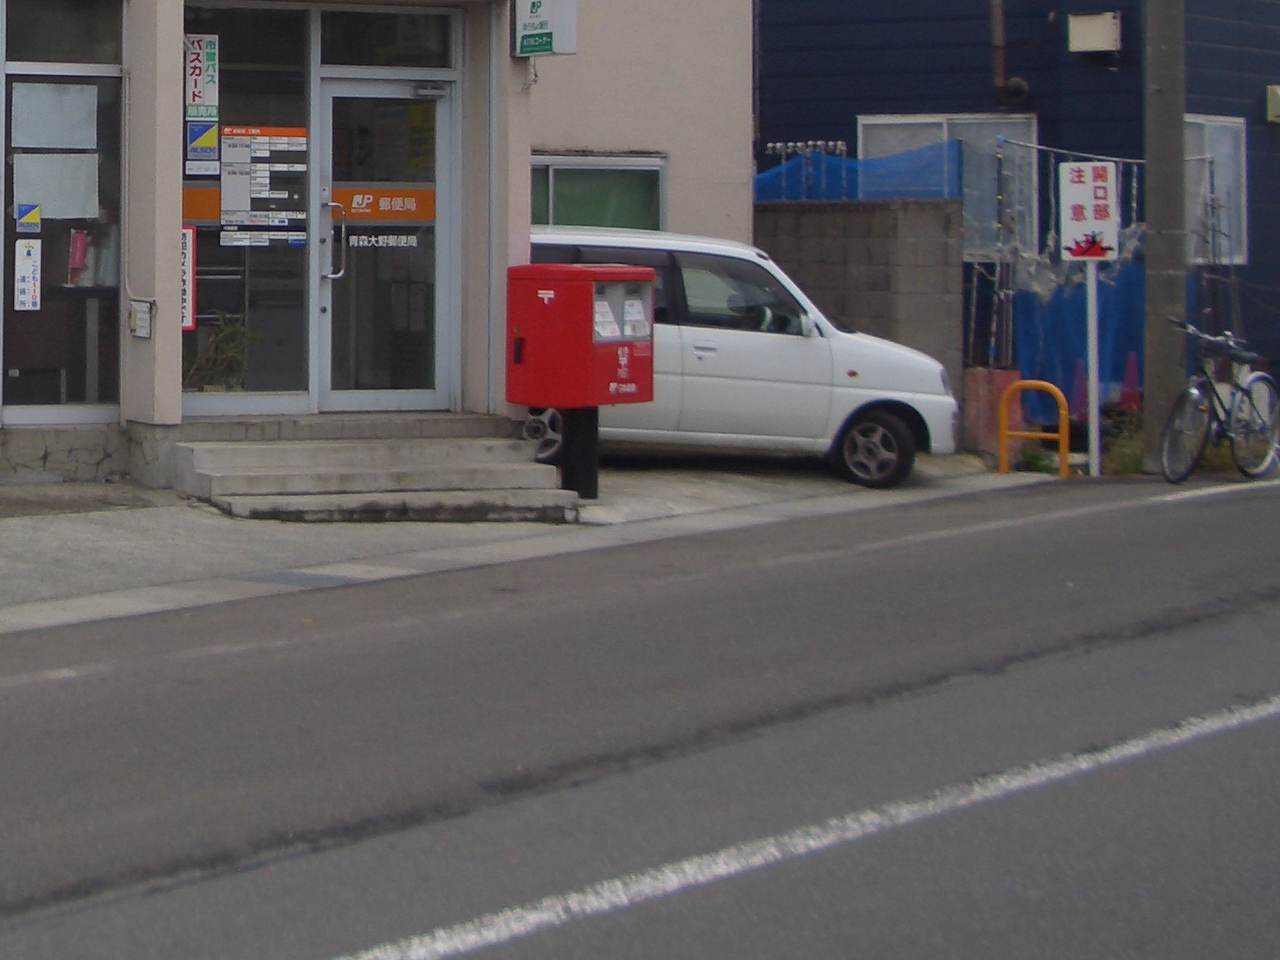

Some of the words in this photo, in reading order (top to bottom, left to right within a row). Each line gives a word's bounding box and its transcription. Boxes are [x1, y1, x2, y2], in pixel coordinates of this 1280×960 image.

[189, 39, 203, 103] バスカード
[379, 197, 417, 211] 郵便局
[349, 235, 418, 247] 青森大野郵便局
